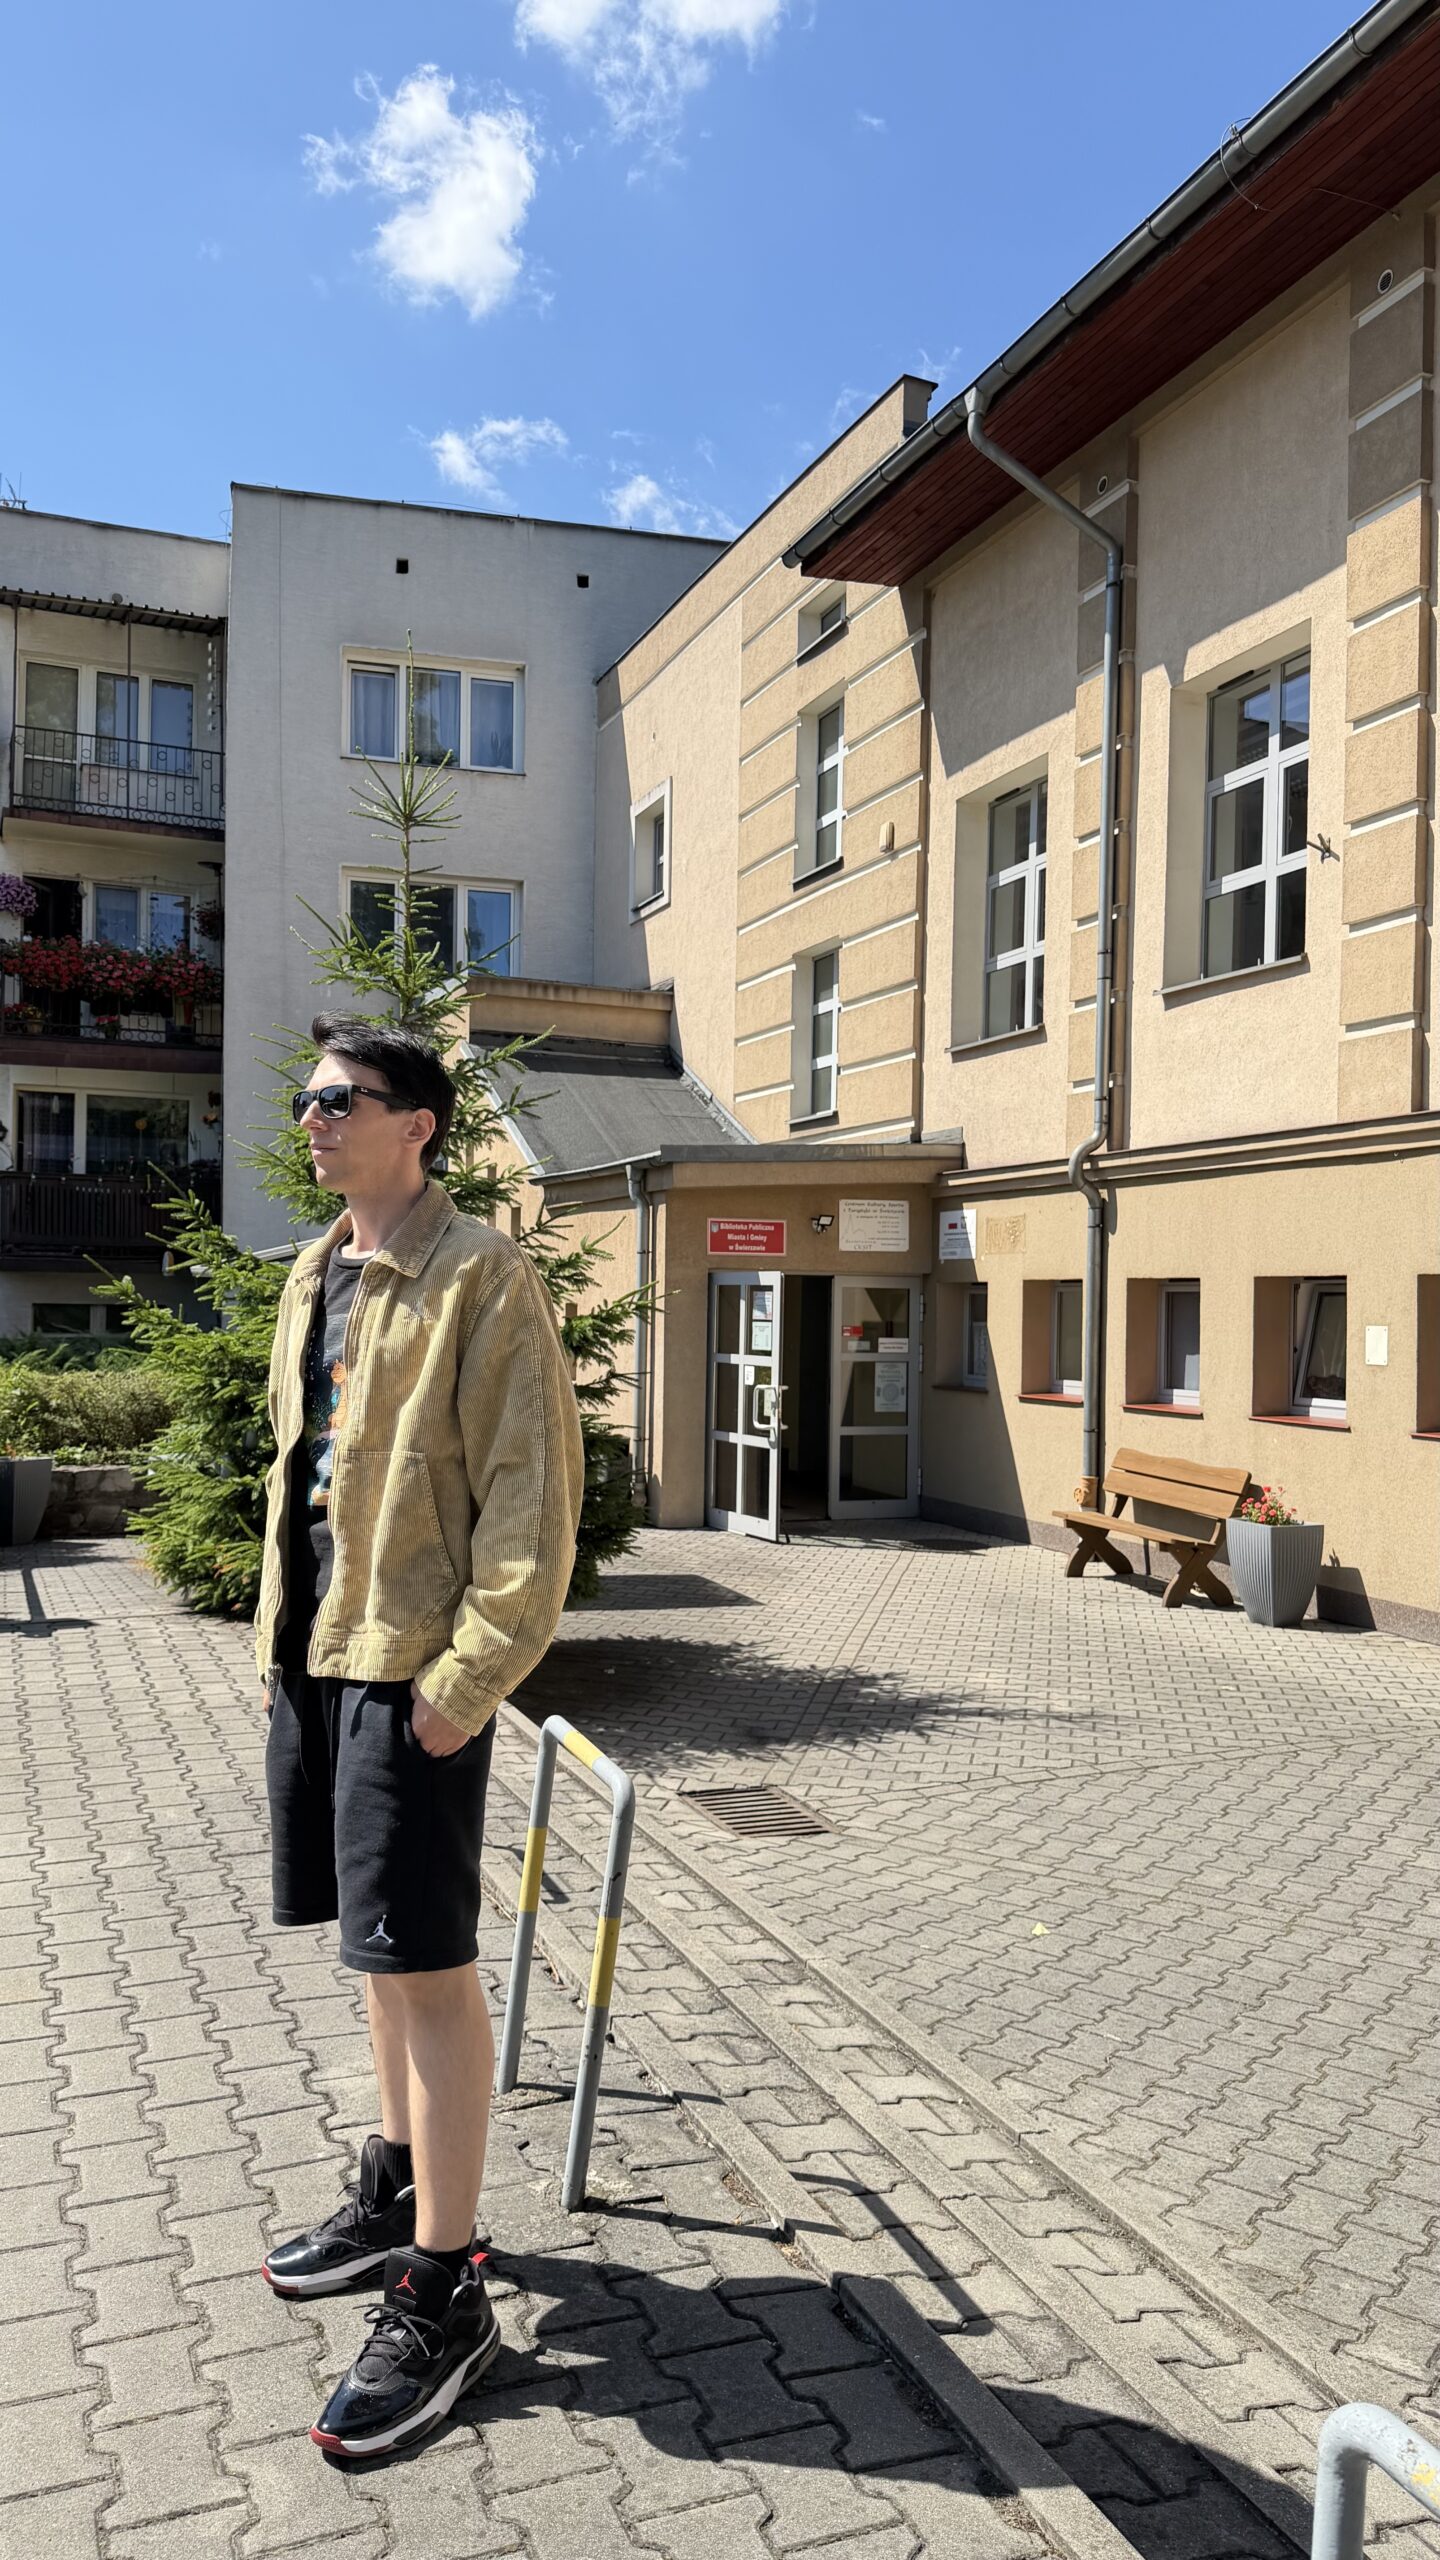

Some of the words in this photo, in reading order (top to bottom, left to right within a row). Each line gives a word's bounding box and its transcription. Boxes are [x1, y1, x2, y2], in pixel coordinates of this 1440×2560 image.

[720, 1222, 748, 1231] Biblioteka
[750, 1234, 767, 1242] Gminy
[735, 1242, 766, 1251] Świerzawie
